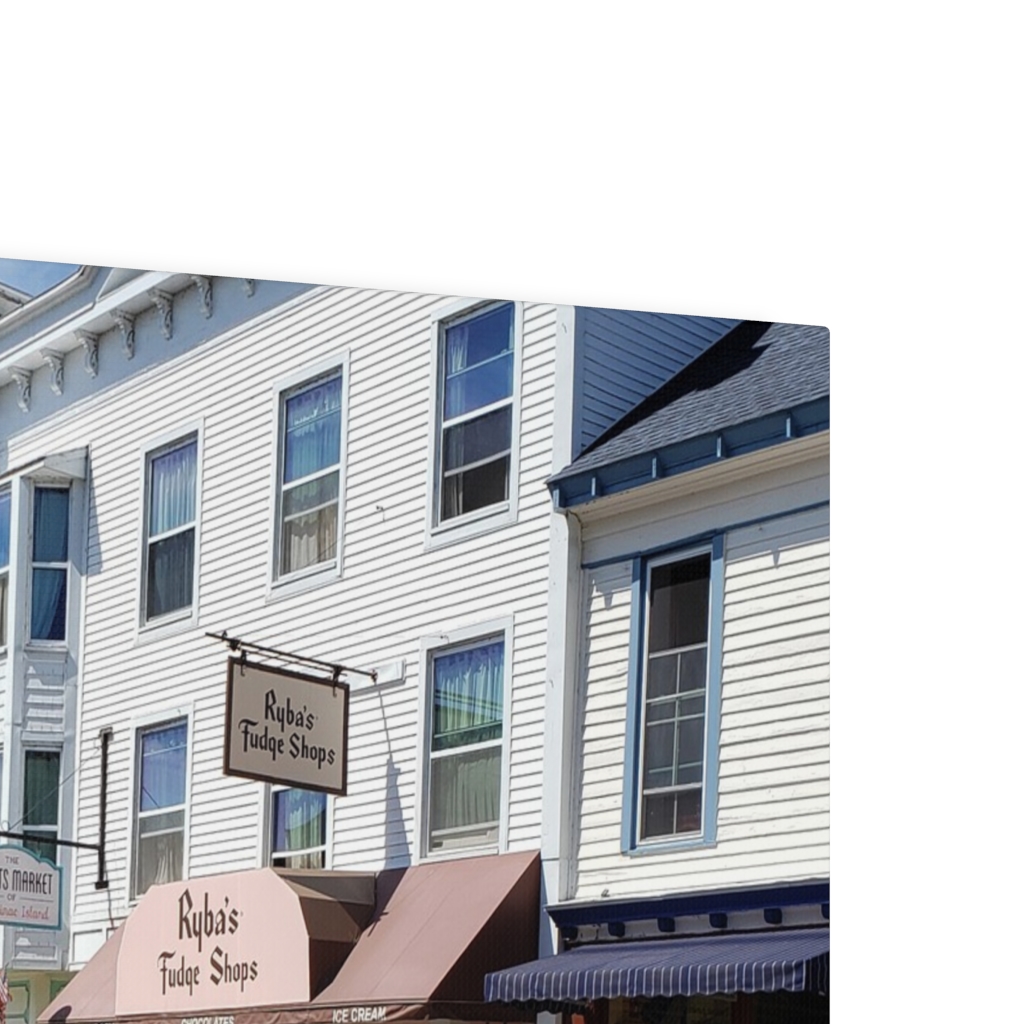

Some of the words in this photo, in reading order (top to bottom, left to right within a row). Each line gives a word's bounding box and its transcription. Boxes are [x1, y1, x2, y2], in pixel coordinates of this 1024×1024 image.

[265, 689, 315, 732] Ryba's
[238, 719, 284, 761] Fudge
[289, 733, 336, 769] Shops
[5, 856, 19, 864] THE
[12, 869, 53, 894] MARKET
[22, 905, 49, 920] Island
[178, 888, 239, 952] Ryba's
[157, 951, 200, 996] Fudge
[210, 946, 258, 992] Shops
[332, 1009, 349, 1023] ICE
[351, 1006, 387, 1023] CREAM
